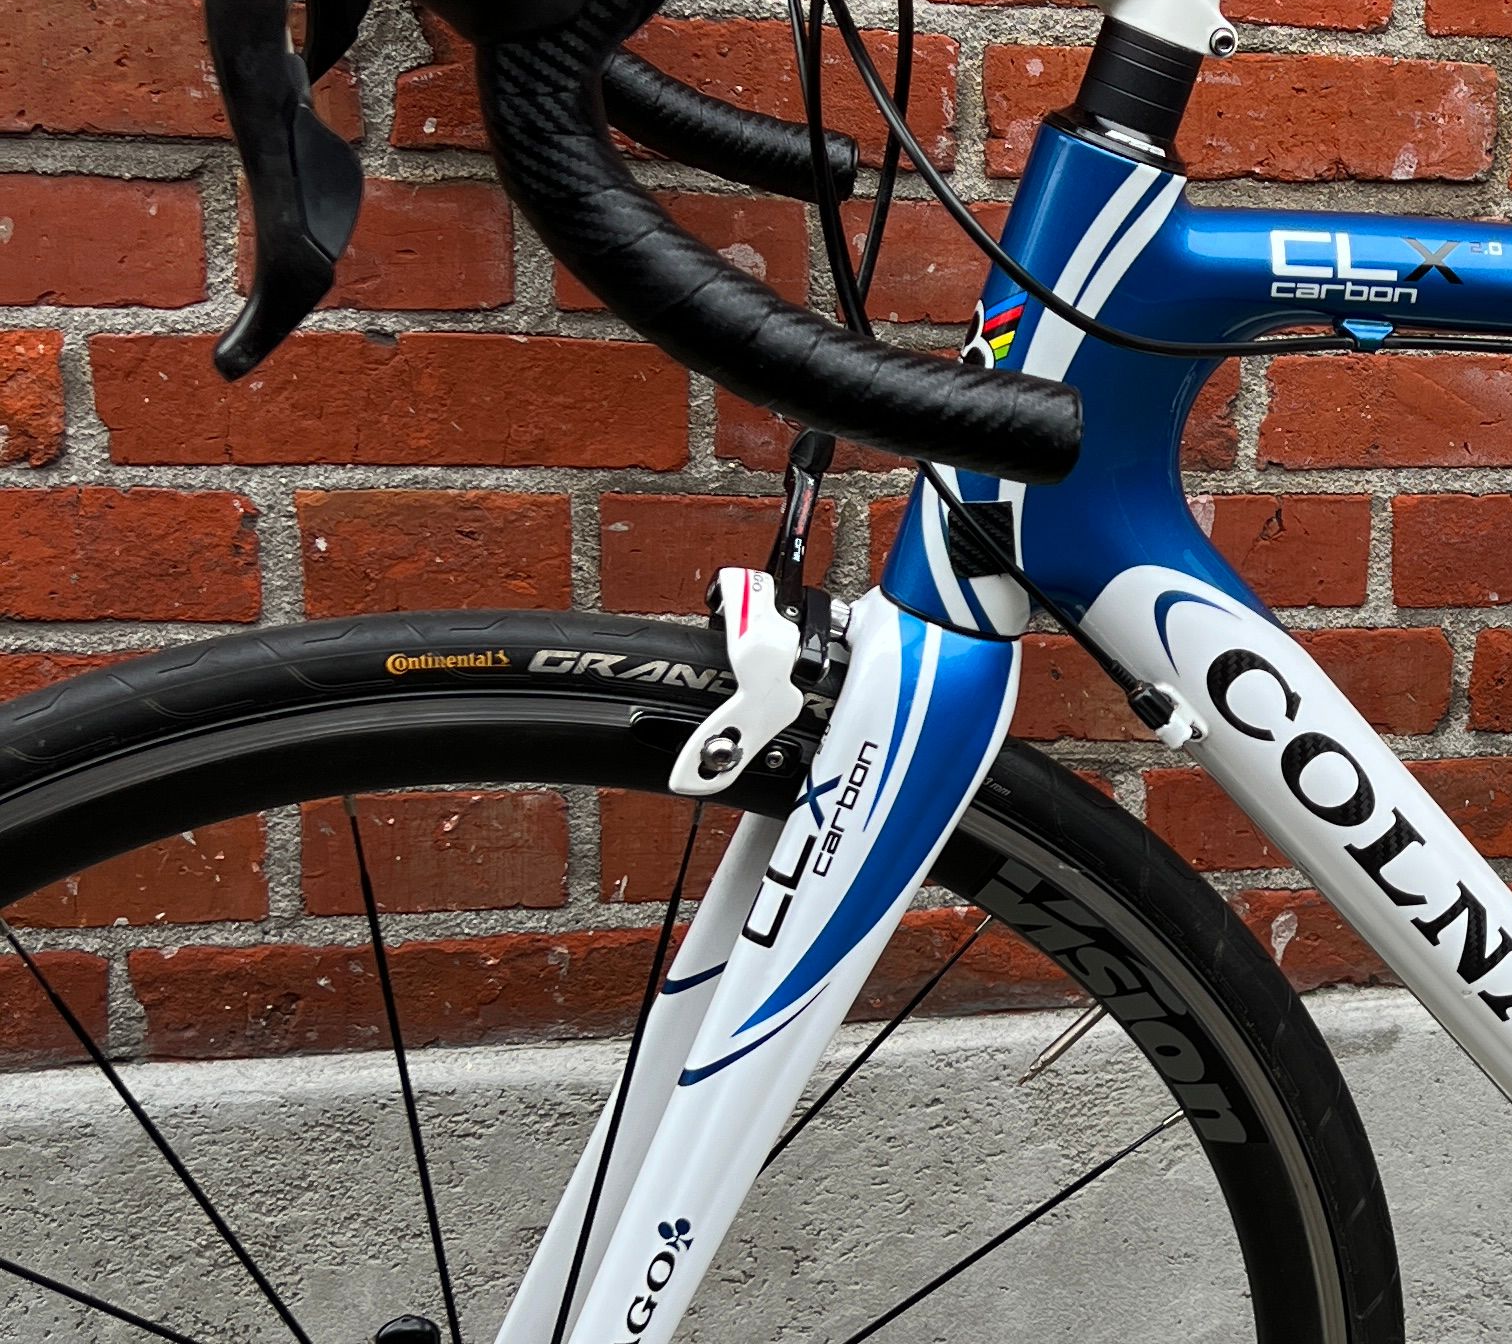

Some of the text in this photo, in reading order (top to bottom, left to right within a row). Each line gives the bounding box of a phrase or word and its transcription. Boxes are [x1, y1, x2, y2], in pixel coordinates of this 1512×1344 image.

[1270, 229, 1464, 285] CLX
[1270, 281, 1418, 304] carbon
[385, 650, 493, 675] Continental
[813, 741, 878, 877] carbon
[741, 773, 843, 949] CLX
